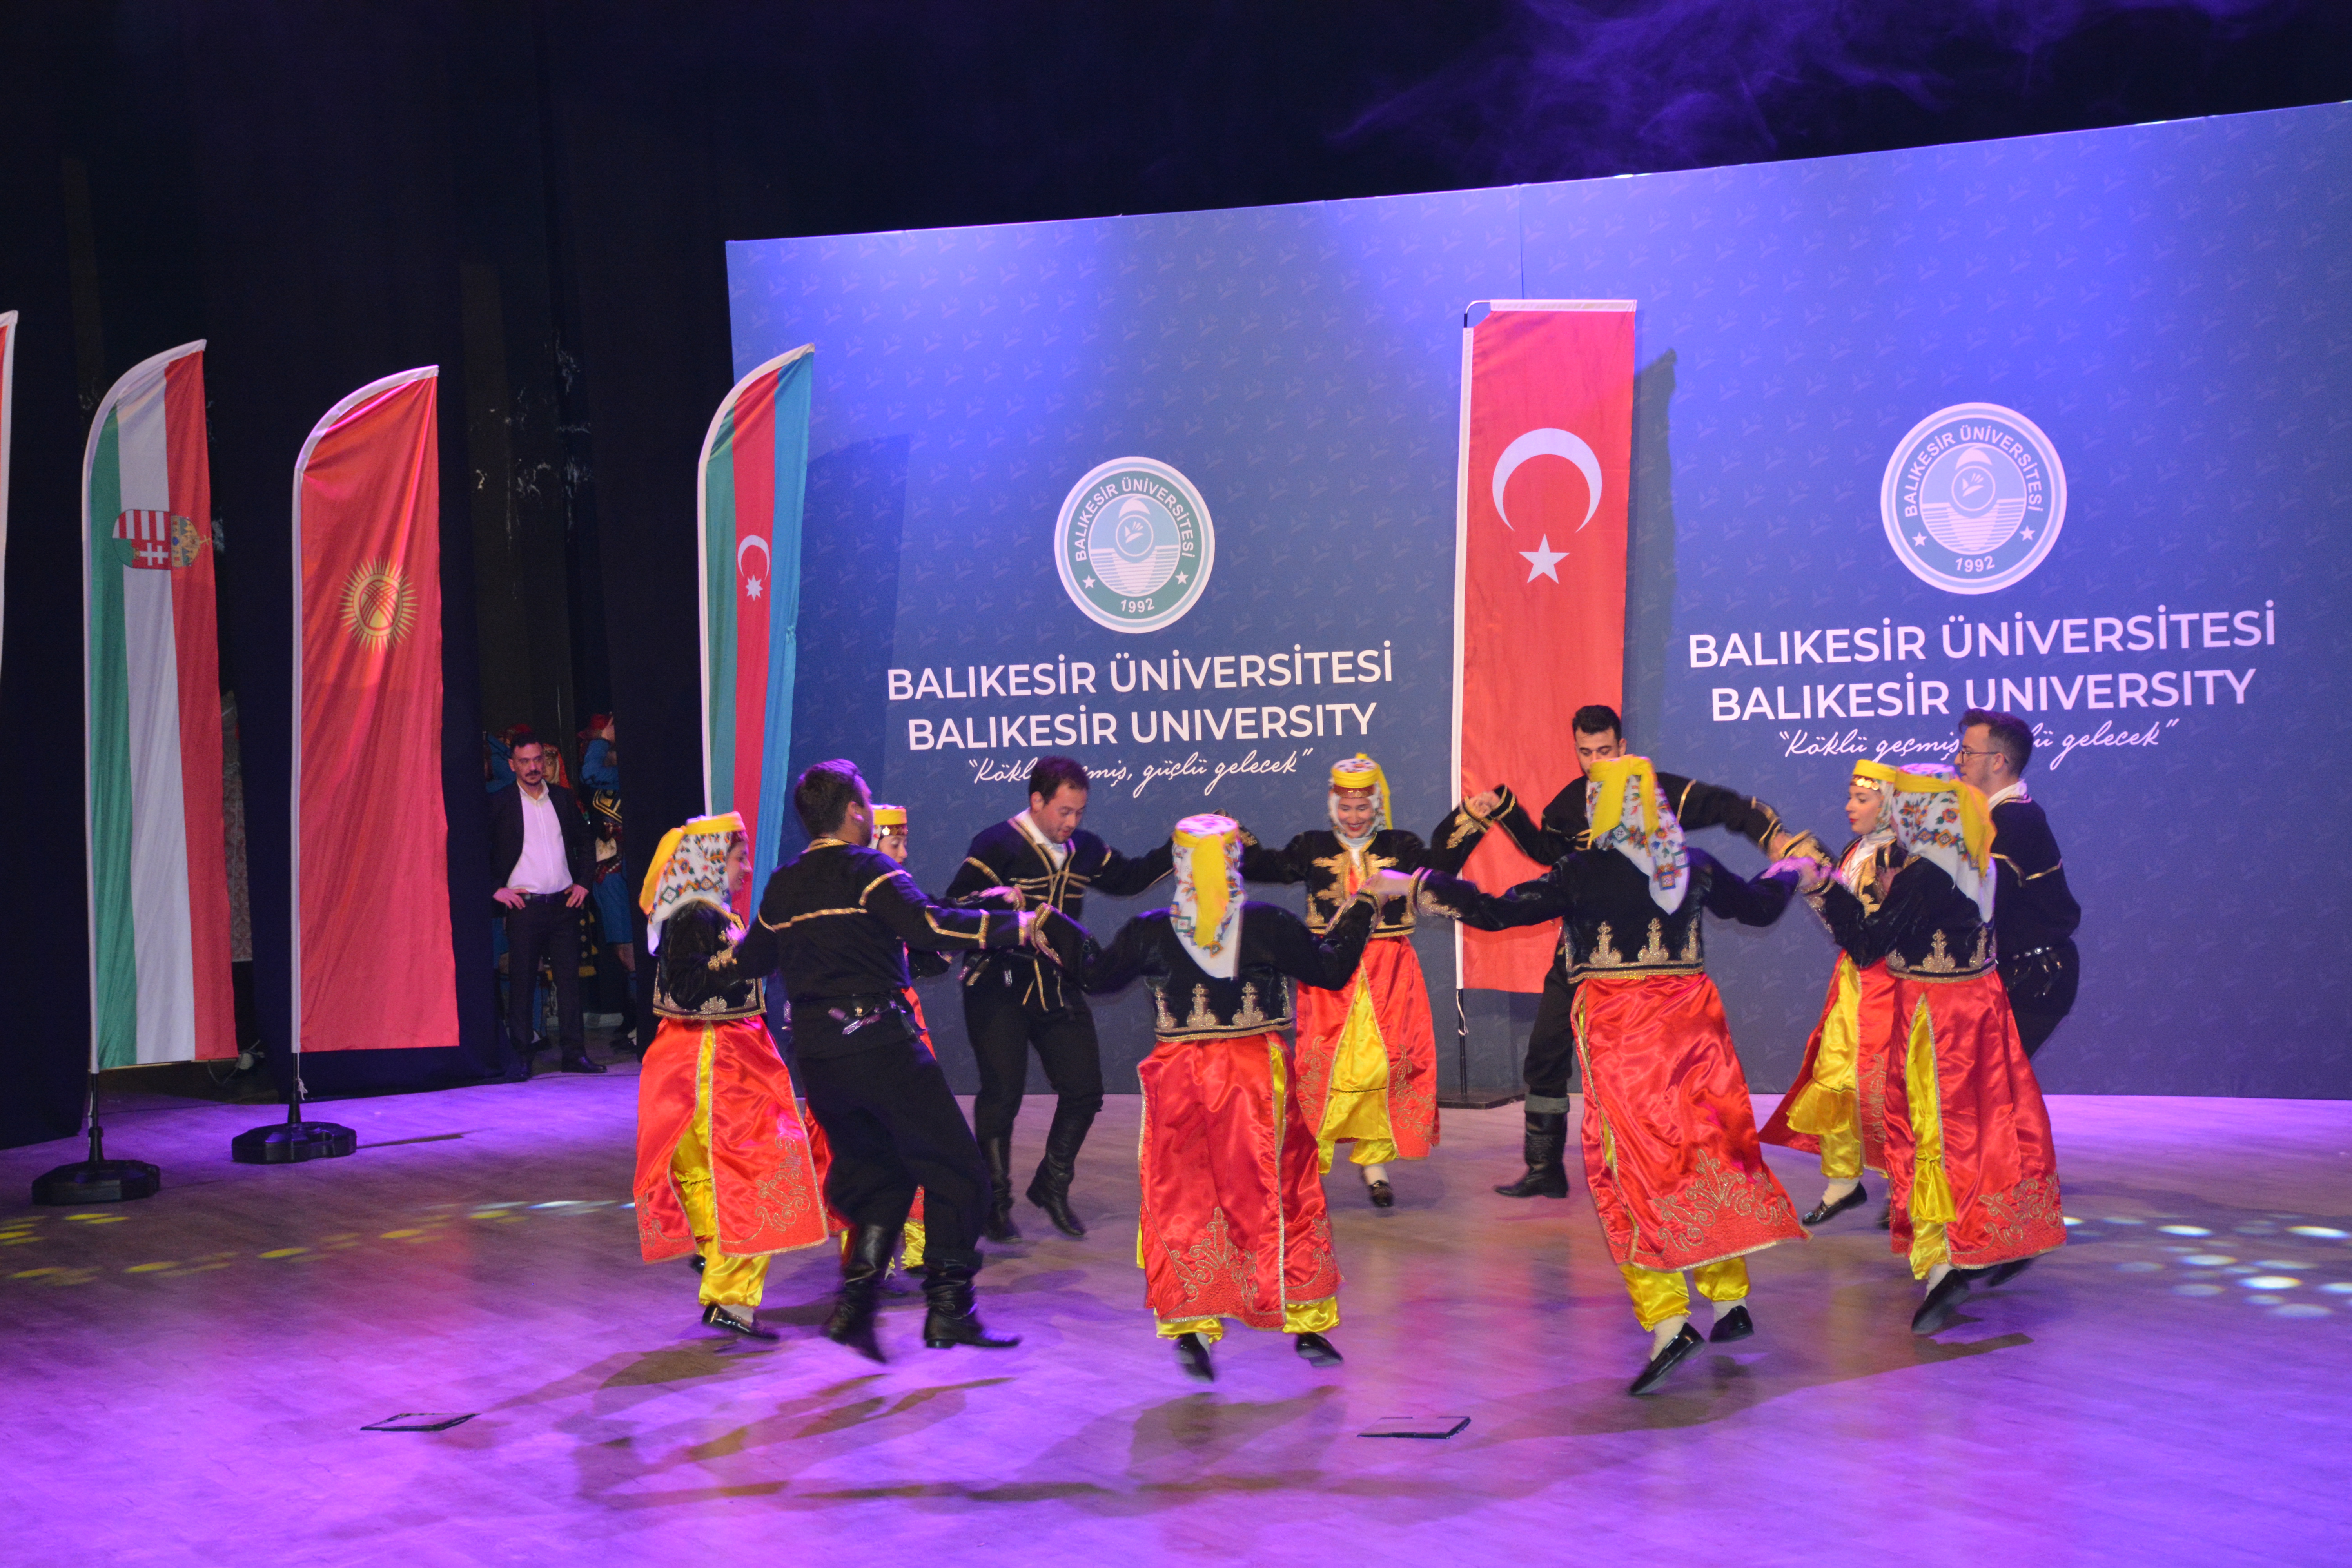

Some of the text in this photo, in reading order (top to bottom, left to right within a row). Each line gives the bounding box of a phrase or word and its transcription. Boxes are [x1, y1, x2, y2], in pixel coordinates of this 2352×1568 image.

[1904, 425, 2043, 517] BALIKESİR ÜNİVERSİTESİ
[1074, 477, 1195, 561] BALIKESİR ÜNİVERSİTESİ
[1956, 556, 1995, 572] 1992
[1121, 598, 1155, 613] 1992
[1690, 600, 2274, 668] BALIKESİR ÜNİVERSİTESİ
[888, 640, 1392, 700] BALIKESİR ÜNİVERSİTESİ
[1712, 669, 2256, 721] BALIKESİR UNIVERSITY
[909, 702, 1377, 750] BALIKESİR UNIVERSITY
[969, 757, 1038, 784] “Kökl
[1133, 751, 1207, 798] güçlü
